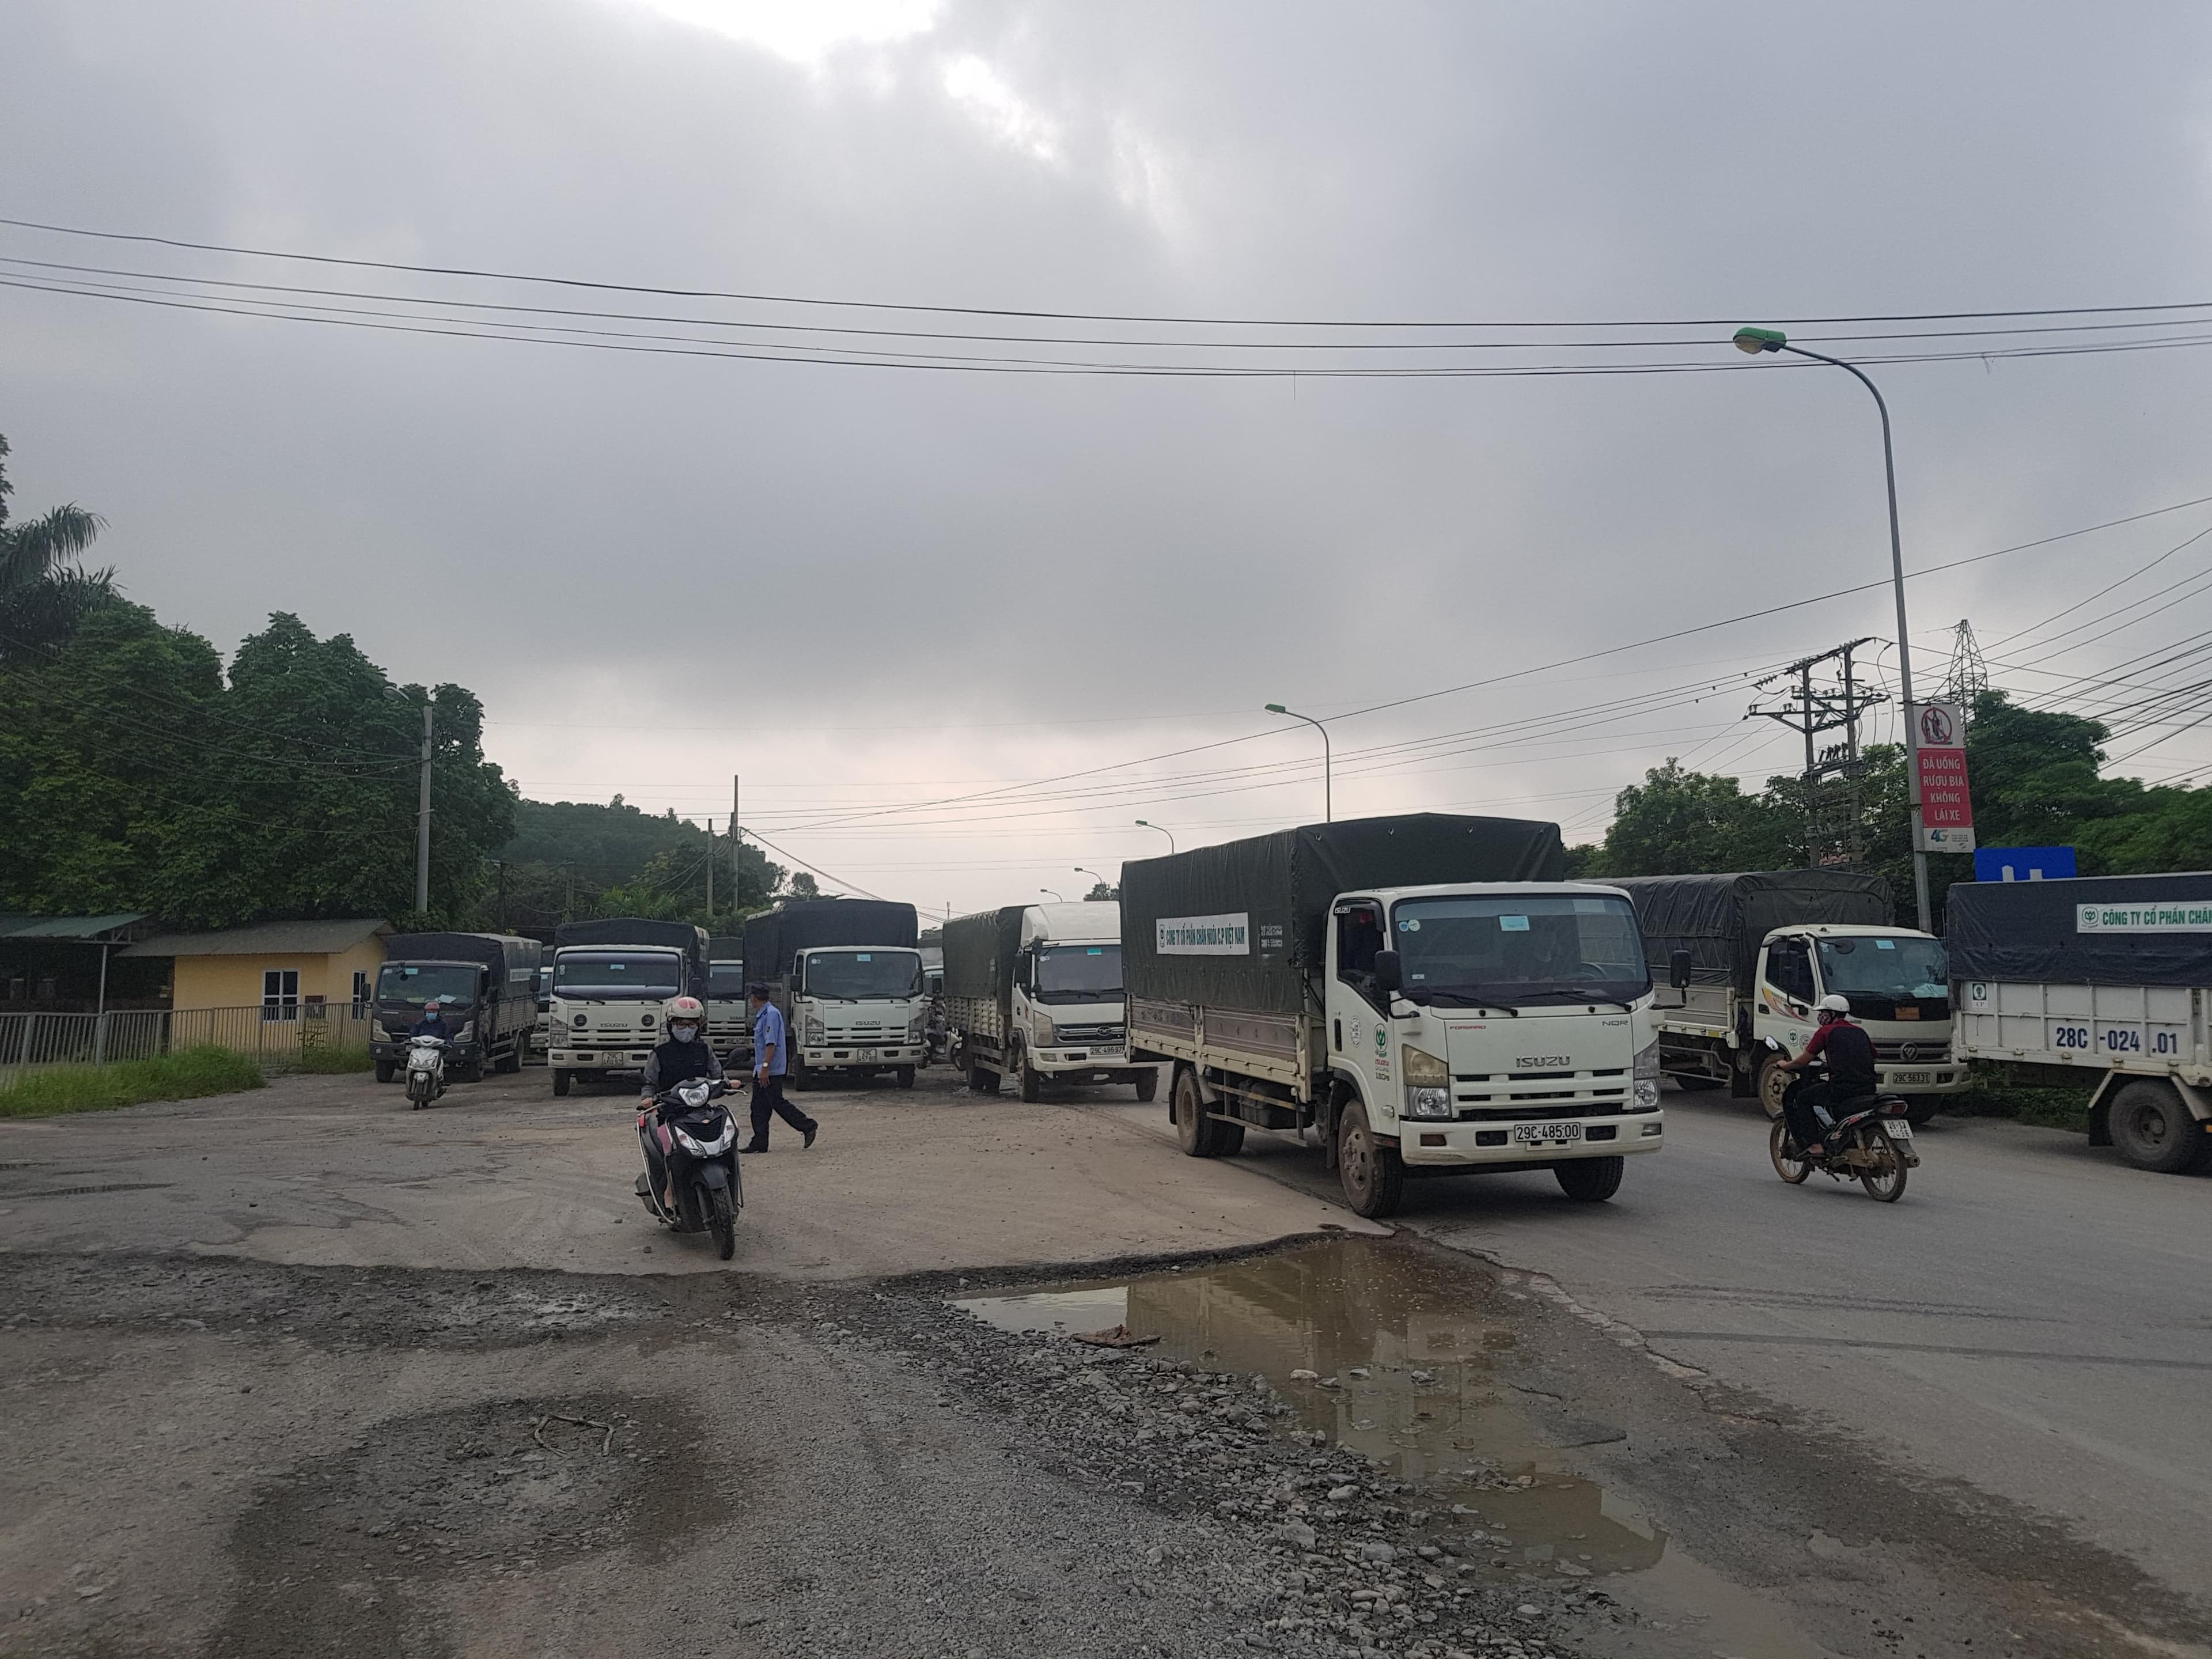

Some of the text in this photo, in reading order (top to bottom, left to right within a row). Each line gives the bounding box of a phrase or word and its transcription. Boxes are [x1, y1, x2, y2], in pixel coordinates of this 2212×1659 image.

[1923, 756, 1960, 770] ĐÃ UỐNG
[1923, 775, 1964, 789] RƯỢU BIA
[1930, 791, 1961, 803] KHÔNG
[1935, 808, 1960, 821] LÁI XE
[1931, 830, 1948, 842] 4G
[2103, 908, 2127, 925] CÔNG
[2130, 911, 2141, 925] TY
[2143, 905, 2157, 925] CỔ
[2056, 1027, 2088, 1049] 28C
[1516, 1054, 1570, 1067] ISUZU
